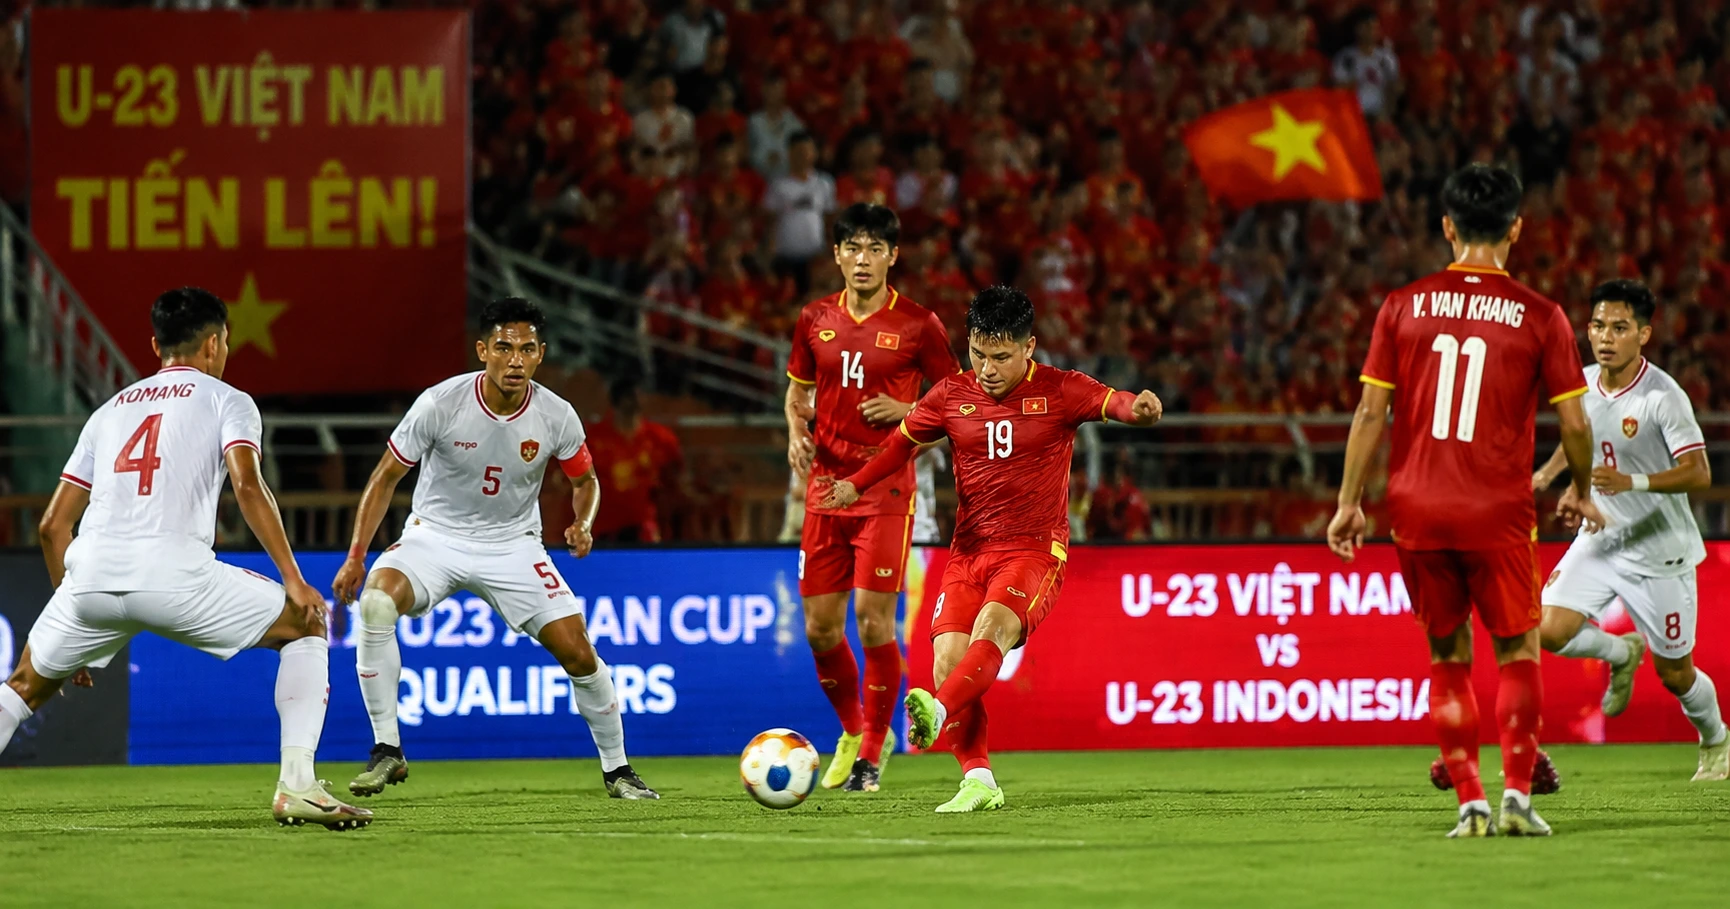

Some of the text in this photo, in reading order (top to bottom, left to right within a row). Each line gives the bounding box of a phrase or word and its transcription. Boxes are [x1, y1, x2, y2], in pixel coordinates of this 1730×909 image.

[56, 50, 445, 142] U-23 VIỆT NAM
[56, 148, 438, 250] TIẾN LÊN!
[1412, 291, 1526, 329] V. VAN KHANG
[840, 350, 865, 389] 14
[1431, 333, 1488, 443] 11
[114, 383, 196, 407] KOMANG
[114, 413, 163, 496] 4
[984, 420, 1013, 460] 19
[1601, 441, 1617, 470] 8
[482, 465, 503, 496] 5
[533, 561, 560, 590] 5
[1121, 573, 1219, 617] U-23
[1226, 561, 1320, 625] VIỆT
[670, 595, 775, 644] CUP
[1665, 611, 1681, 641] 8
[1105, 680, 1203, 725] U-23
